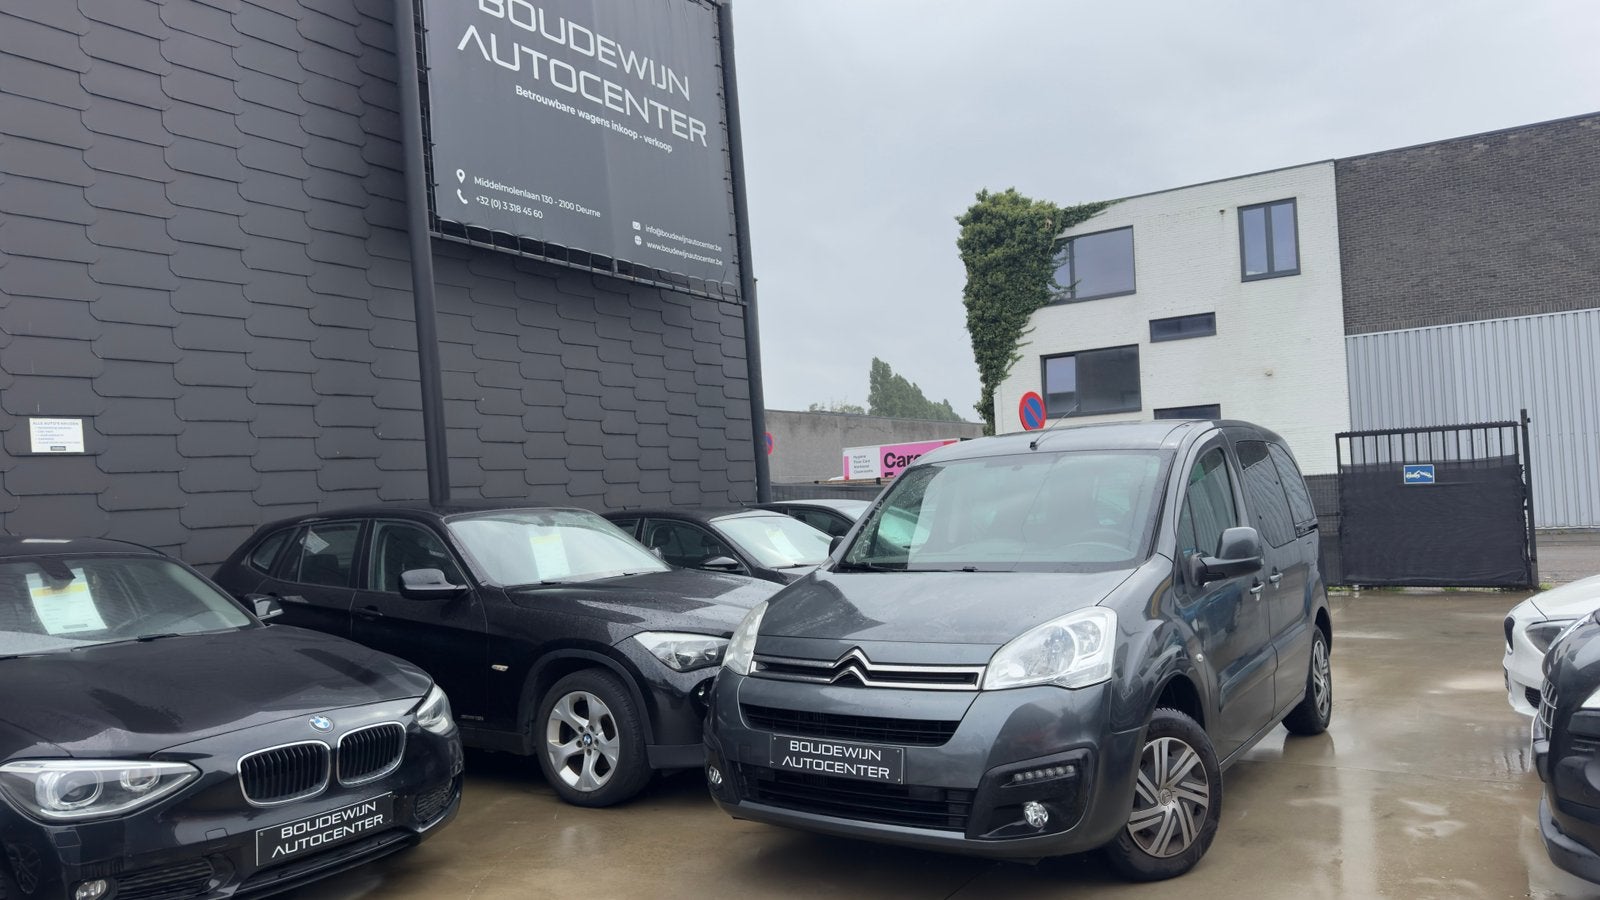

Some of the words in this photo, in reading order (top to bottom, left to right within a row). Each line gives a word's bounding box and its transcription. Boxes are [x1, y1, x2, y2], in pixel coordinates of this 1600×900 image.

[478, 0, 691, 101] BOUDEWIJN
[457, 25, 708, 147] AUTOCENTER
[515, 85, 577, 115] Betrouwbare
[577, 109, 611, 128] wagens
[611, 120, 638, 140] inkoop
[643, 134, 673, 154] verkoop
[474, 176, 541, 202] Middelmolenlaan
[541, 194, 553, 205] 130
[559, 199, 575, 211] 2100
[575, 204, 601, 218] Deurne
[476, 195, 490, 206] +32
[490, 198, 501, 210] (0)
[502, 201, 508, 210] 3
[509, 203, 522, 214] 318
[522, 207, 532, 216] 45
[533, 210, 543, 219] 60
[645, 224, 722, 252] info@boudewijnautocenter.be
[646, 241, 723, 266] www.boudewijnautocenter.be
[782, 755, 890, 779] AUTOCENTER
[790, 740, 882, 762] BOUDEWIJN
[272, 813, 384, 858] AUTOCENTER
[281, 801, 376, 839] BOUDEWIJN
